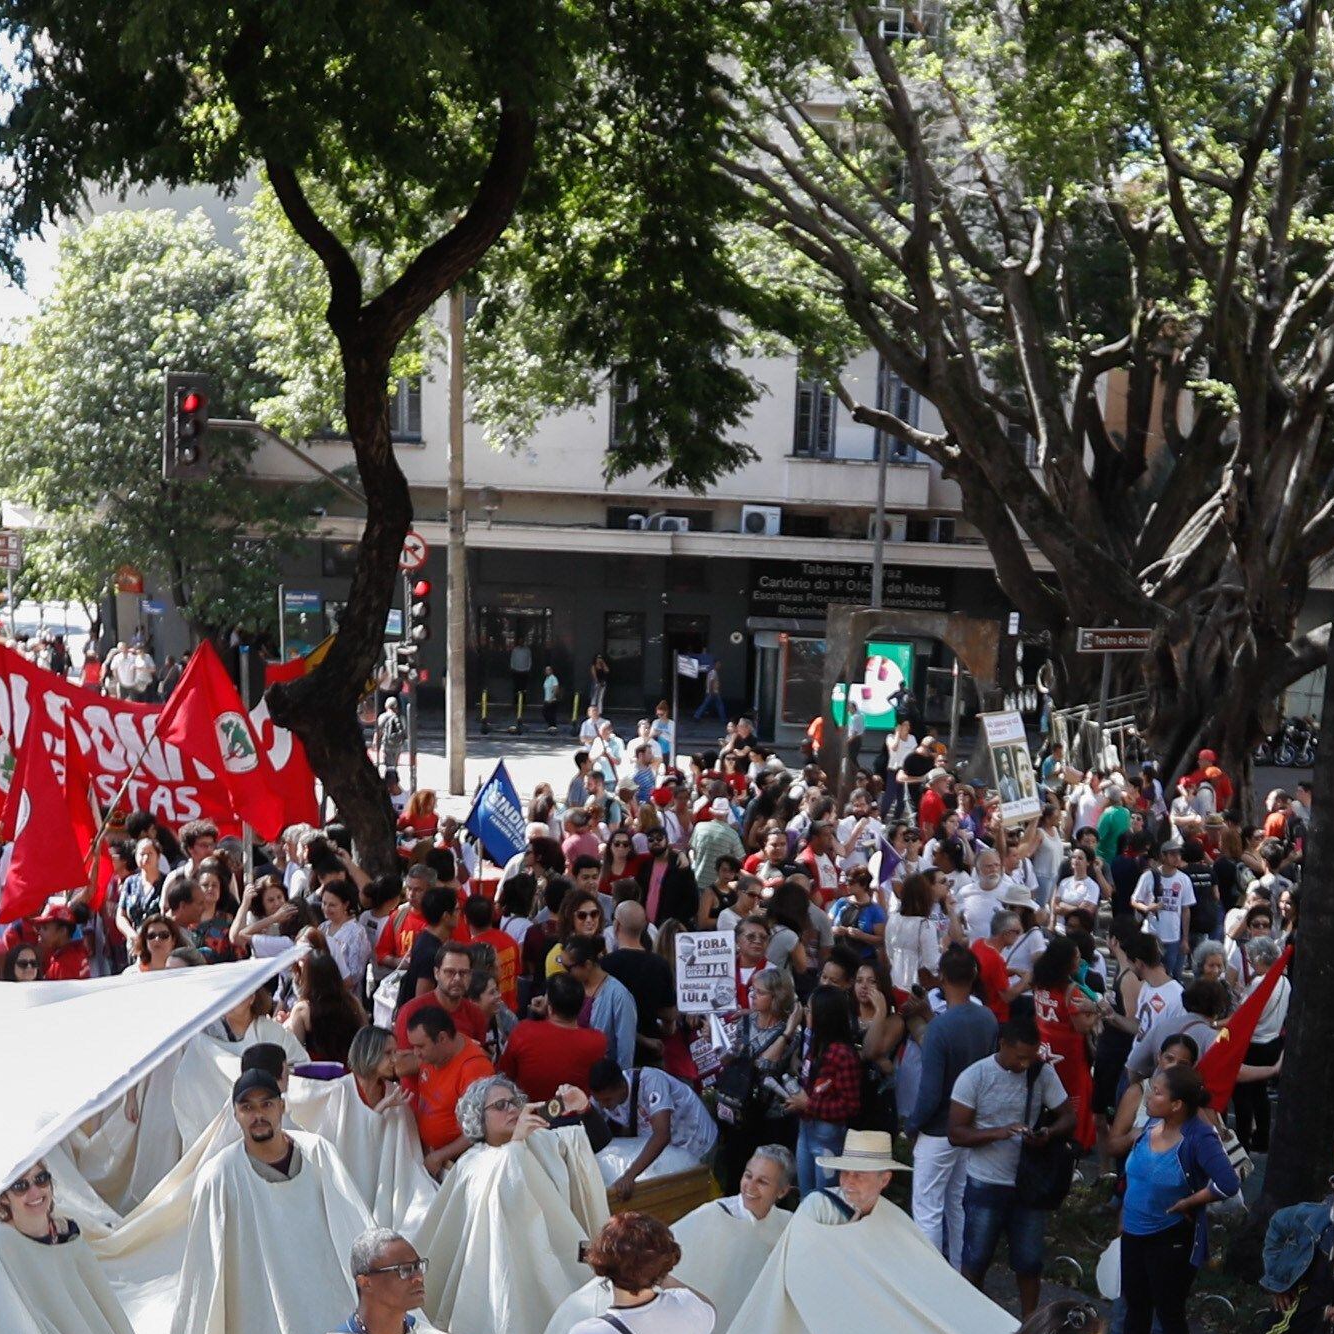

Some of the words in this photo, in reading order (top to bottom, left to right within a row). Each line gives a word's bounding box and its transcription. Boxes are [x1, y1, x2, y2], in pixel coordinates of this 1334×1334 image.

[759, 575, 811, 589] Cartório
[814, 579, 830, 590] do
[887, 582, 902, 593] de
[905, 583, 941, 595] Notas
[1095, 635, 1117, 645] Teatro
[698, 937, 727, 949] FORA
[683, 992, 708, 1003] LULA
